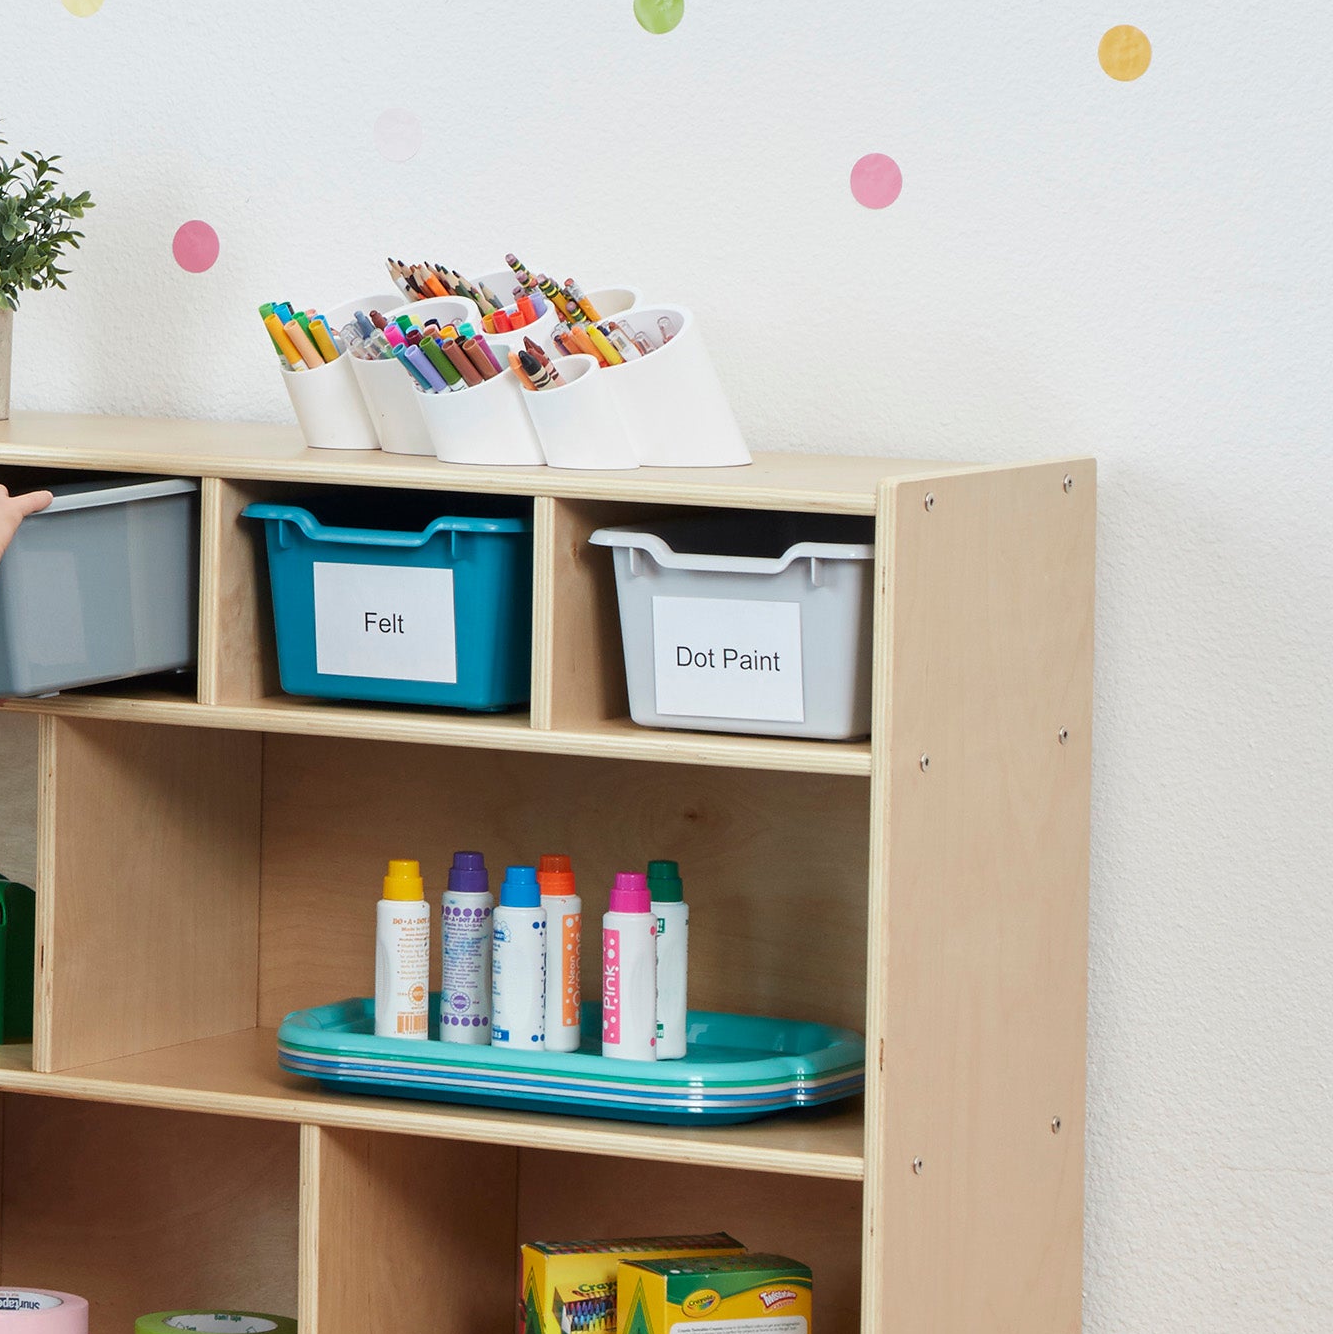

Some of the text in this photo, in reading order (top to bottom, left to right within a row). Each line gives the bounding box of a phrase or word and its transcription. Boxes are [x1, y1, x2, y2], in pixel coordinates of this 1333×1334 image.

[364, 611, 405, 634] Felt
[676, 645, 781, 672] Dot Paint
[568, 955, 577, 985] Neon
[603, 964, 618, 1010] Pink
[578, 1280, 617, 1293] Cray
